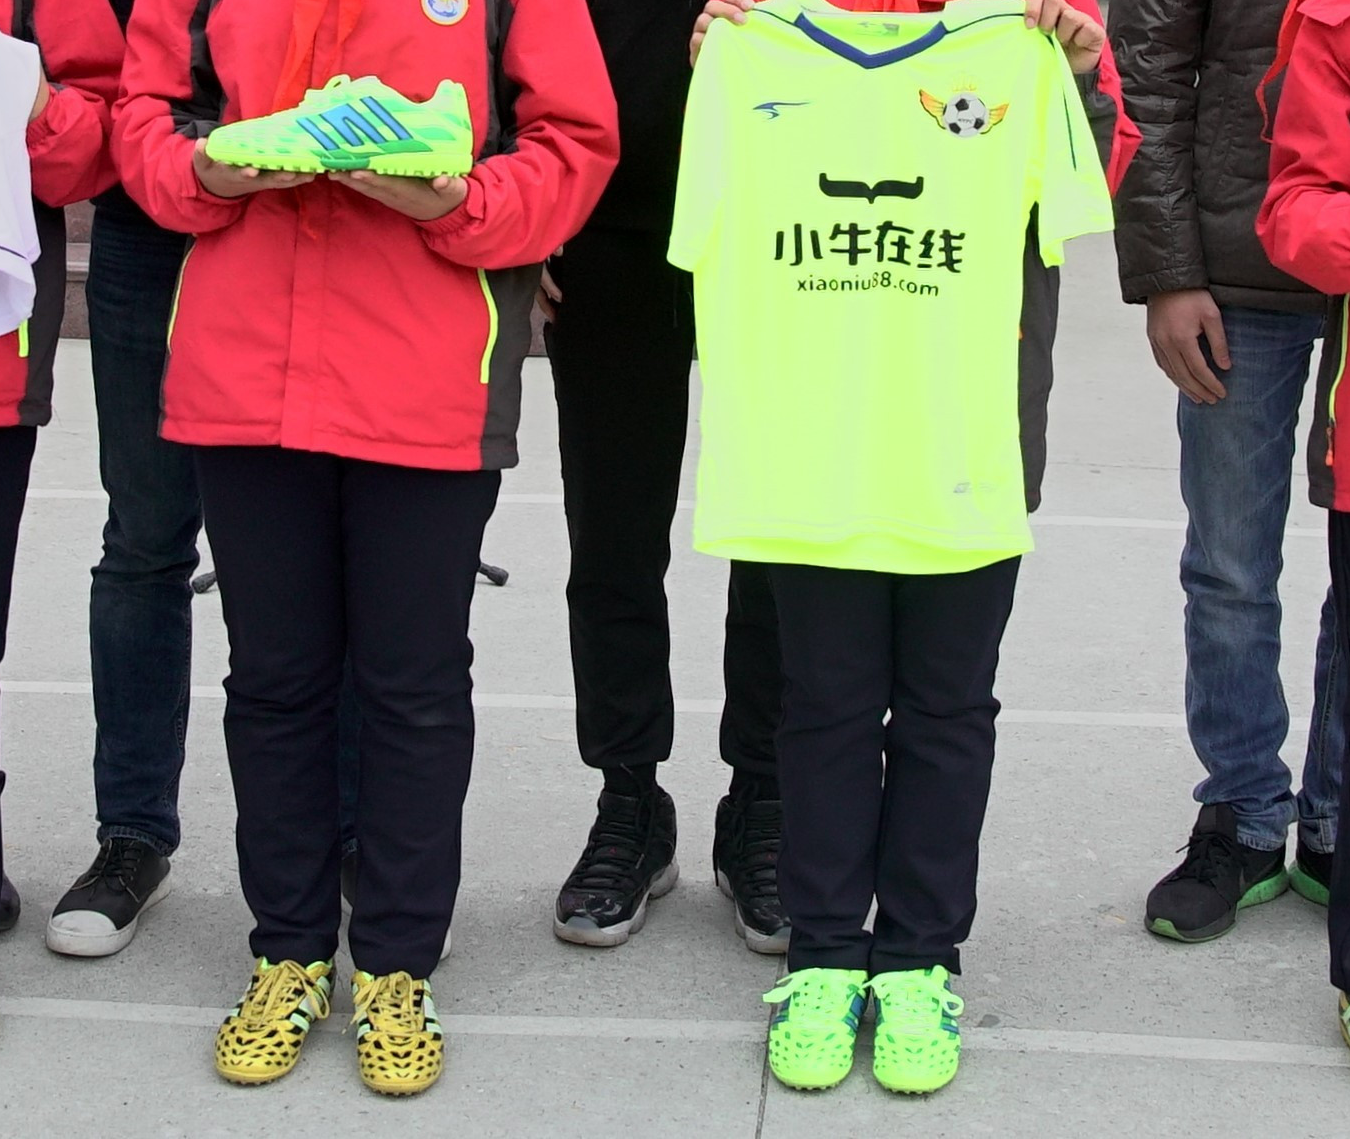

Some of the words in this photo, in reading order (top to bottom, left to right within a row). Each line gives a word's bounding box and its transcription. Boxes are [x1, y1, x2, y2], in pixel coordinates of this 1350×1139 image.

[774, 220, 966, 273] 小牛在线
[797, 271, 939, 296] xiaoniu88.com
